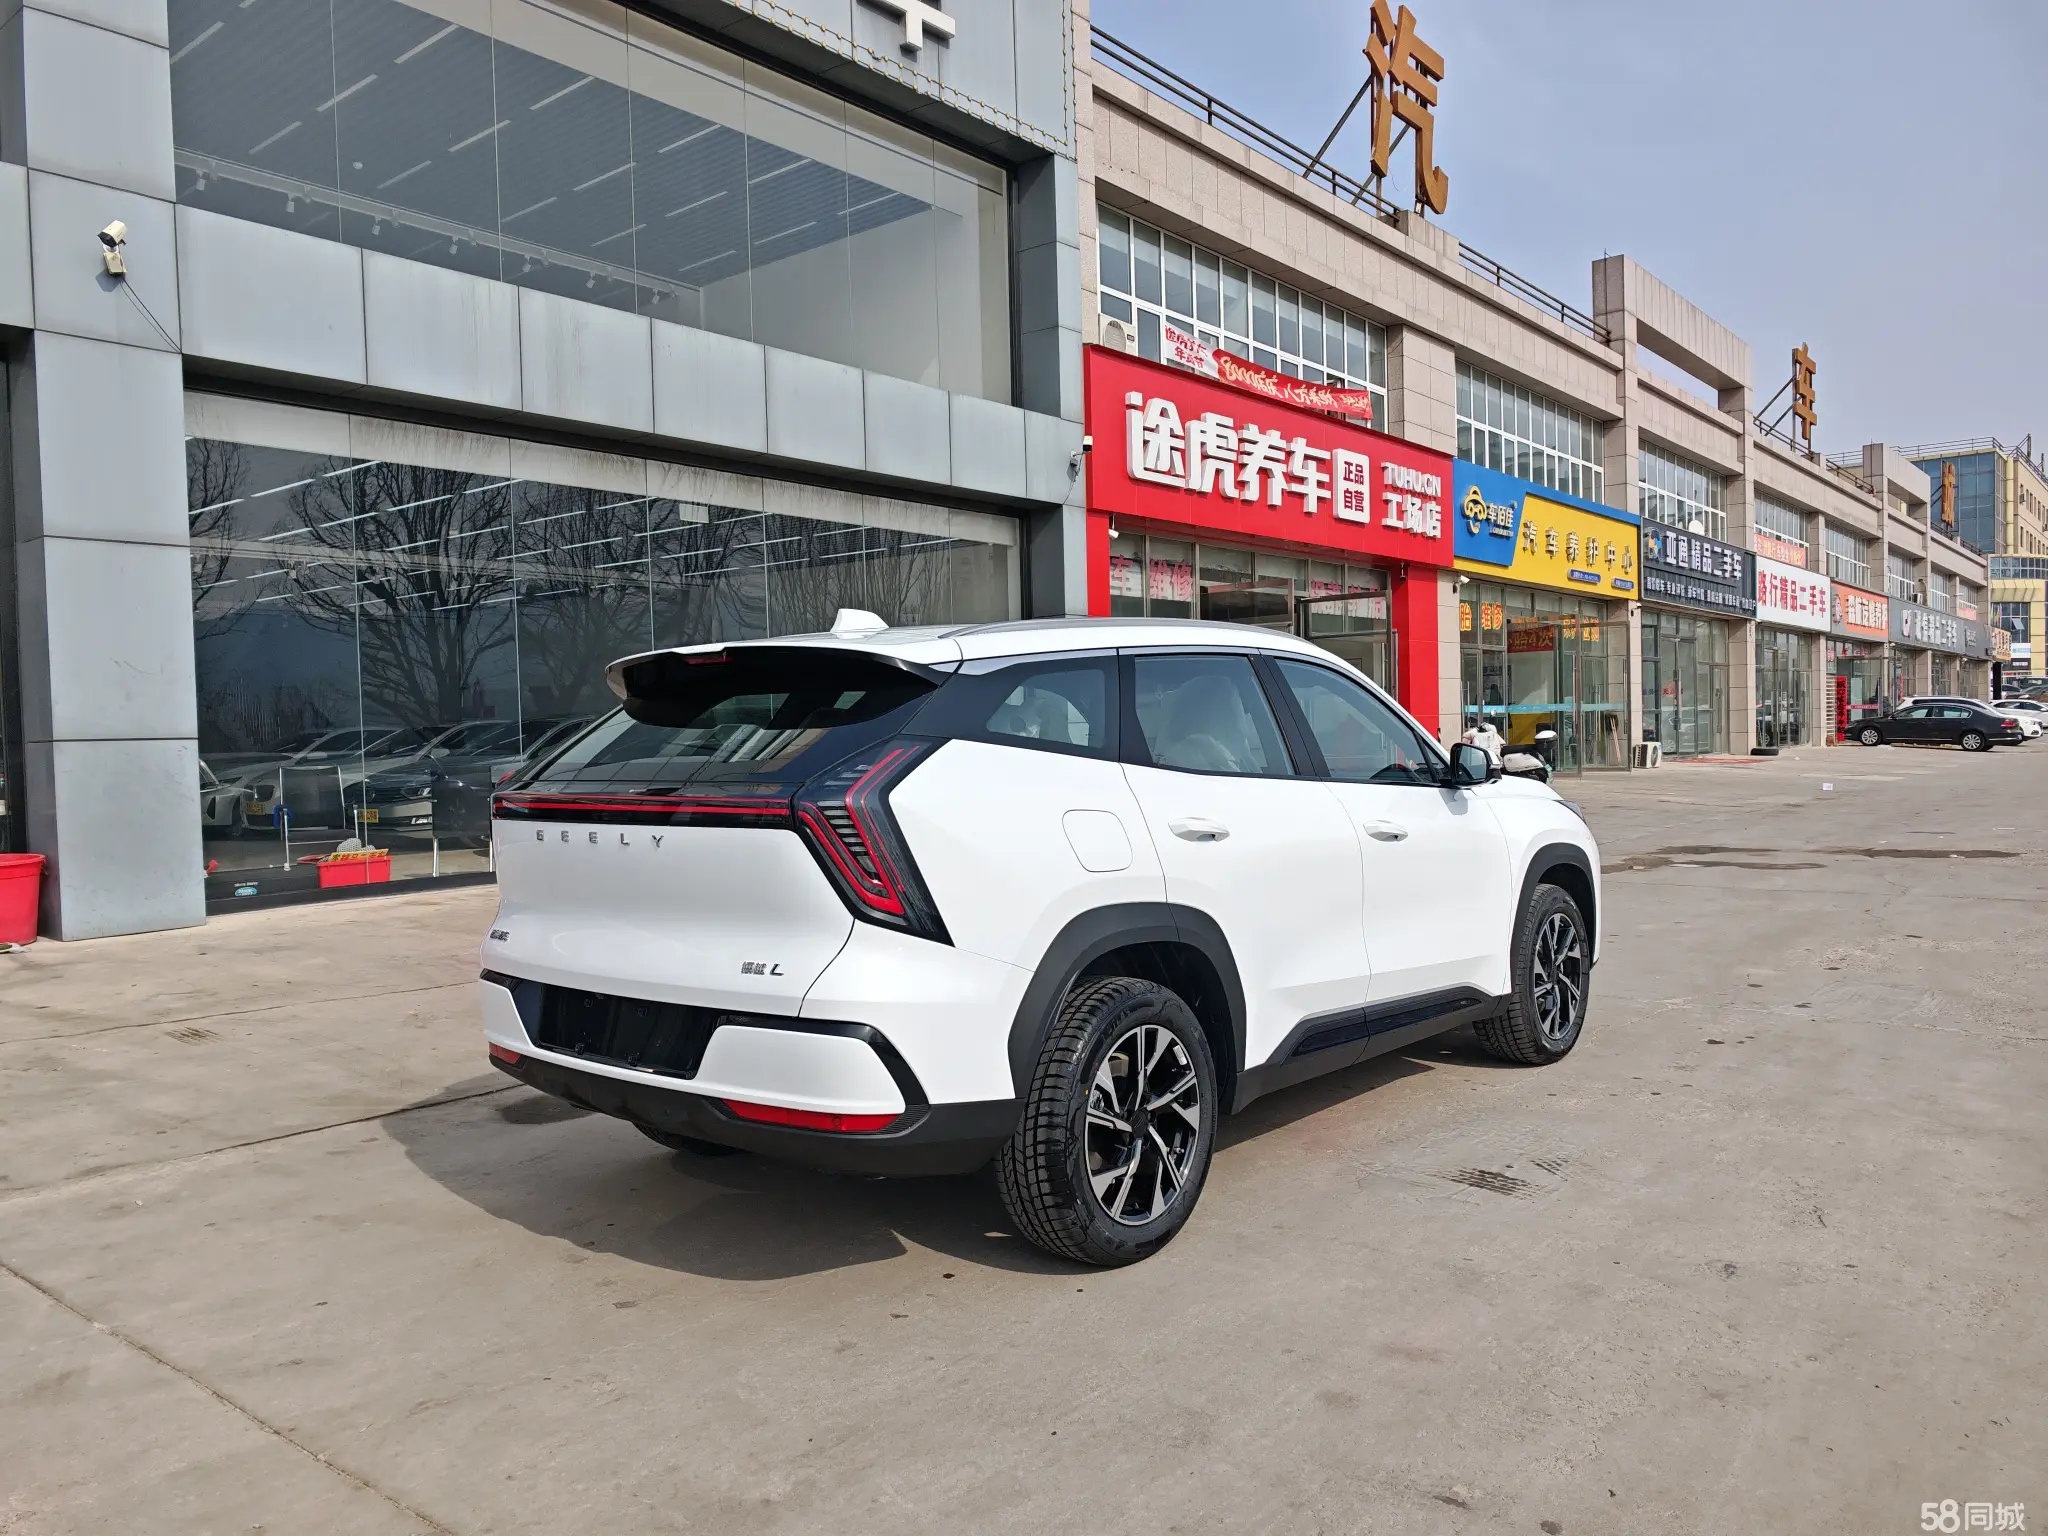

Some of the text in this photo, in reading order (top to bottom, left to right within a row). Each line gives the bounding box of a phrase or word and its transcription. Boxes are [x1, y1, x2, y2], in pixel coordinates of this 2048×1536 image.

[1363, 0, 1449, 214] 汽
[1792, 342, 1818, 441] 车
[1125, 390, 1332, 514] 途虎养车
[1343, 460, 1365, 485] 正品
[1343, 487, 1365, 513] 自营
[1380, 461, 1442, 497] TUHU.CN
[1380, 491, 1442, 539] 工场店
[1487, 502, 1514, 528] 车佰佳
[1522, 519, 1633, 575] 汽车养护中心
[1665, 530, 1742, 581] 亚通精品二手车
[1757, 569, 1827, 619] 路行精品二手车
[1460, 602, 1472, 631] 胎
[1481, 601, 1503, 630] 维修
[535, 829, 665, 849] GEELY
[770, 963, 785, 977] L
